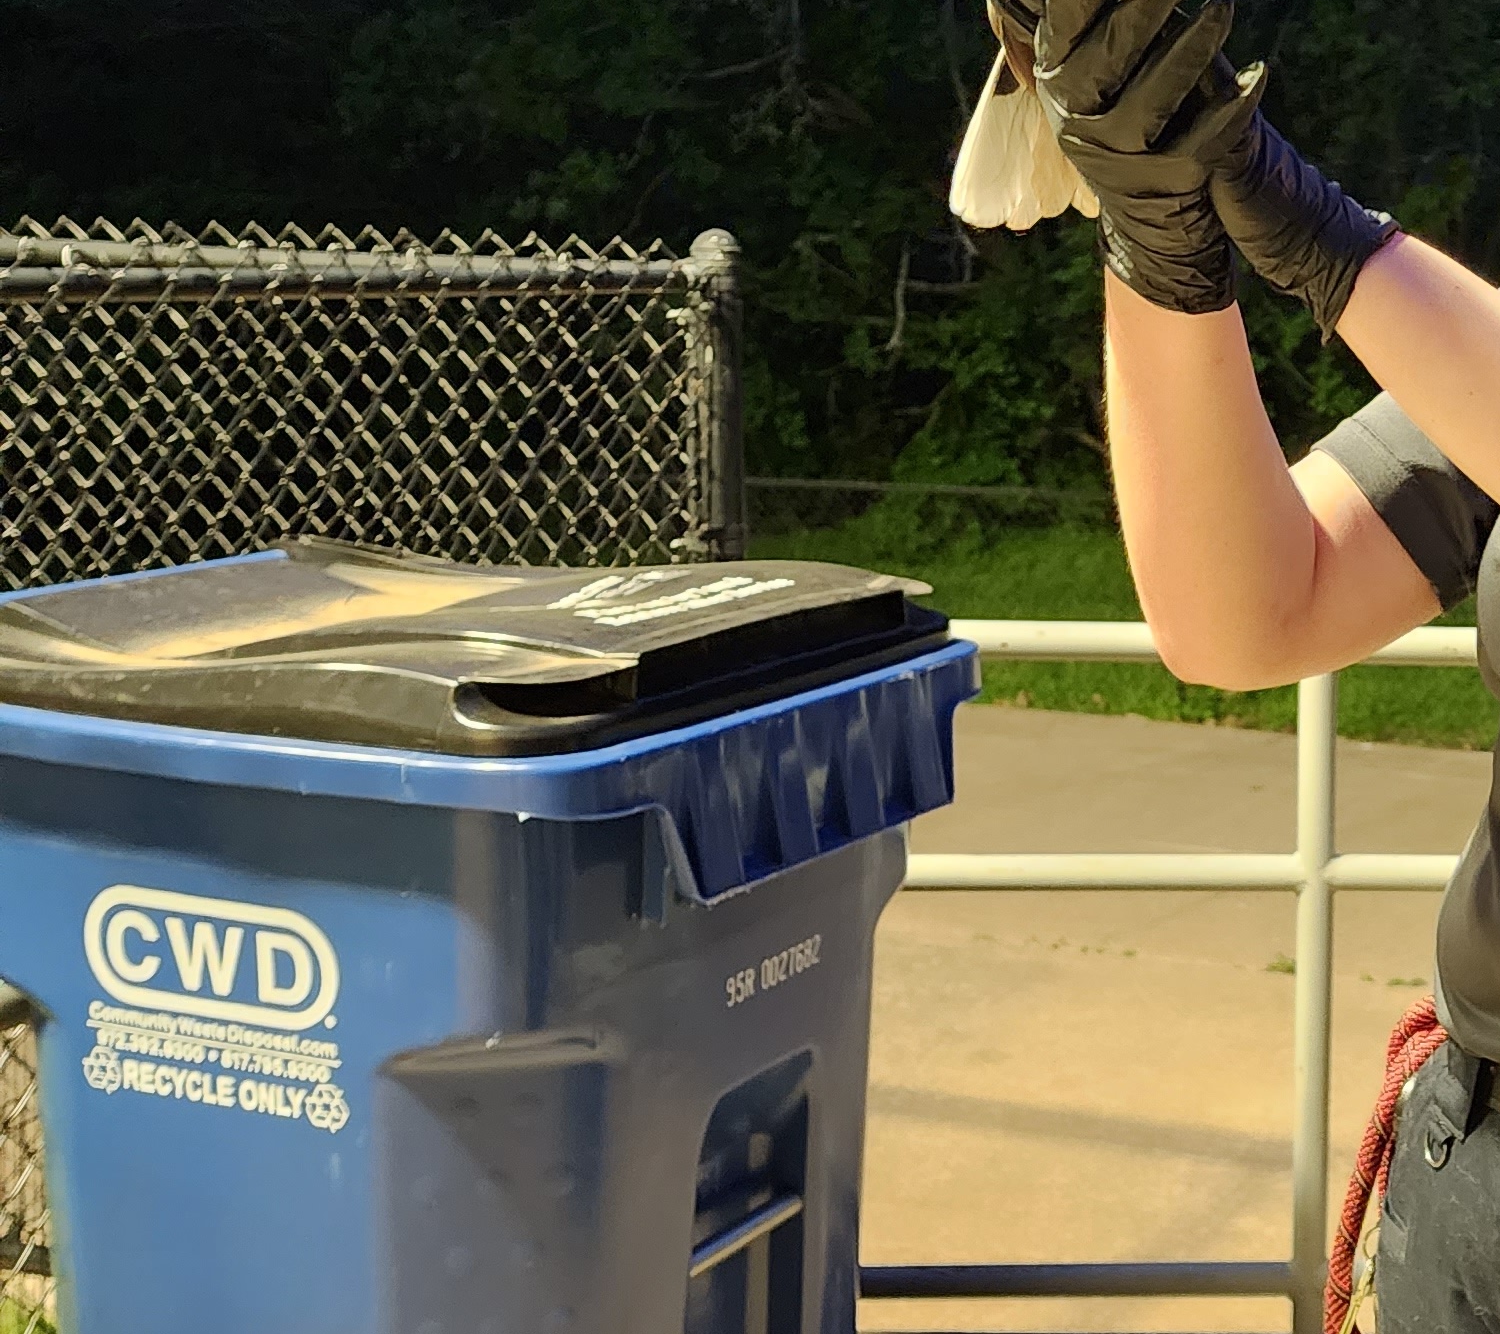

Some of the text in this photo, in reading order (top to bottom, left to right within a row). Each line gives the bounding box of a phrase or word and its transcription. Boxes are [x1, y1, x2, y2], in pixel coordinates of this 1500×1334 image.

[106, 909, 314, 1007] CWD
[122, 1058, 307, 1119] RECYCLE ONLY
